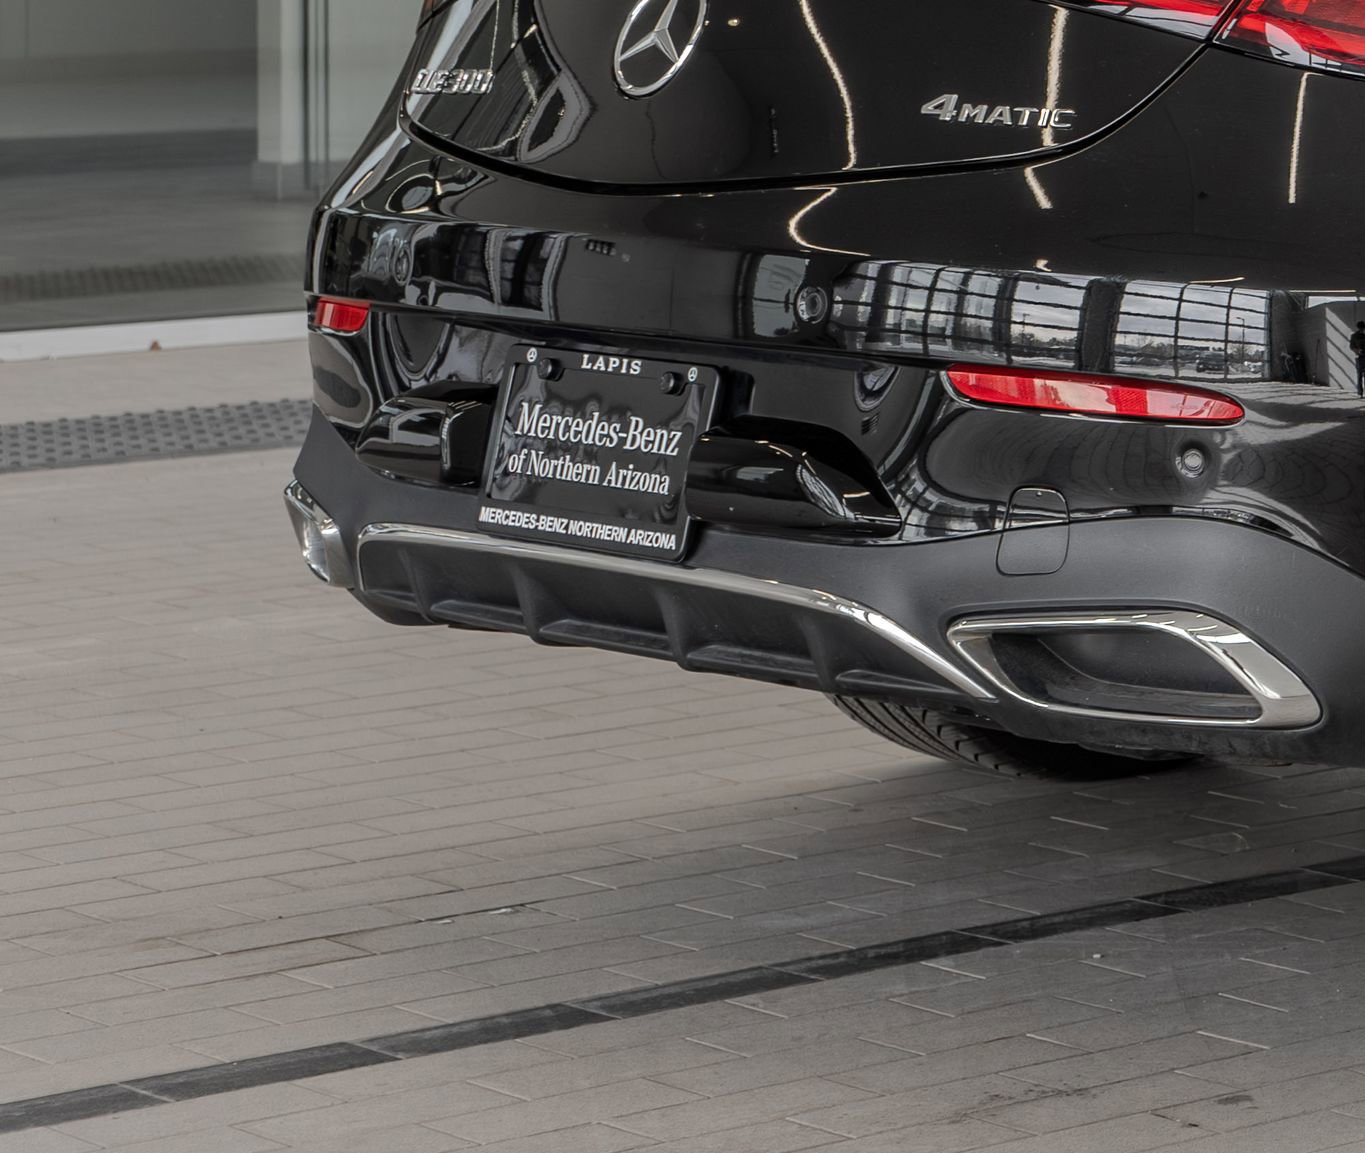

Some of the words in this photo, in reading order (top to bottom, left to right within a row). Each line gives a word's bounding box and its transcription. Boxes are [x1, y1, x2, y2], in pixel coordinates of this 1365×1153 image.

[921, 94, 1076, 128] 4MATIC
[580, 353, 642, 375] LAPIS
[514, 401, 683, 457] Mercedes-Benz
[507, 449, 528, 474] of
[526, 449, 600, 485] Northern
[602, 461, 671, 495] Arizona
[478, 506, 568, 534] MERCEDES-BENZ
[567, 519, 628, 544] NORTHERN
[626, 529, 677, 551] ARIZONA
